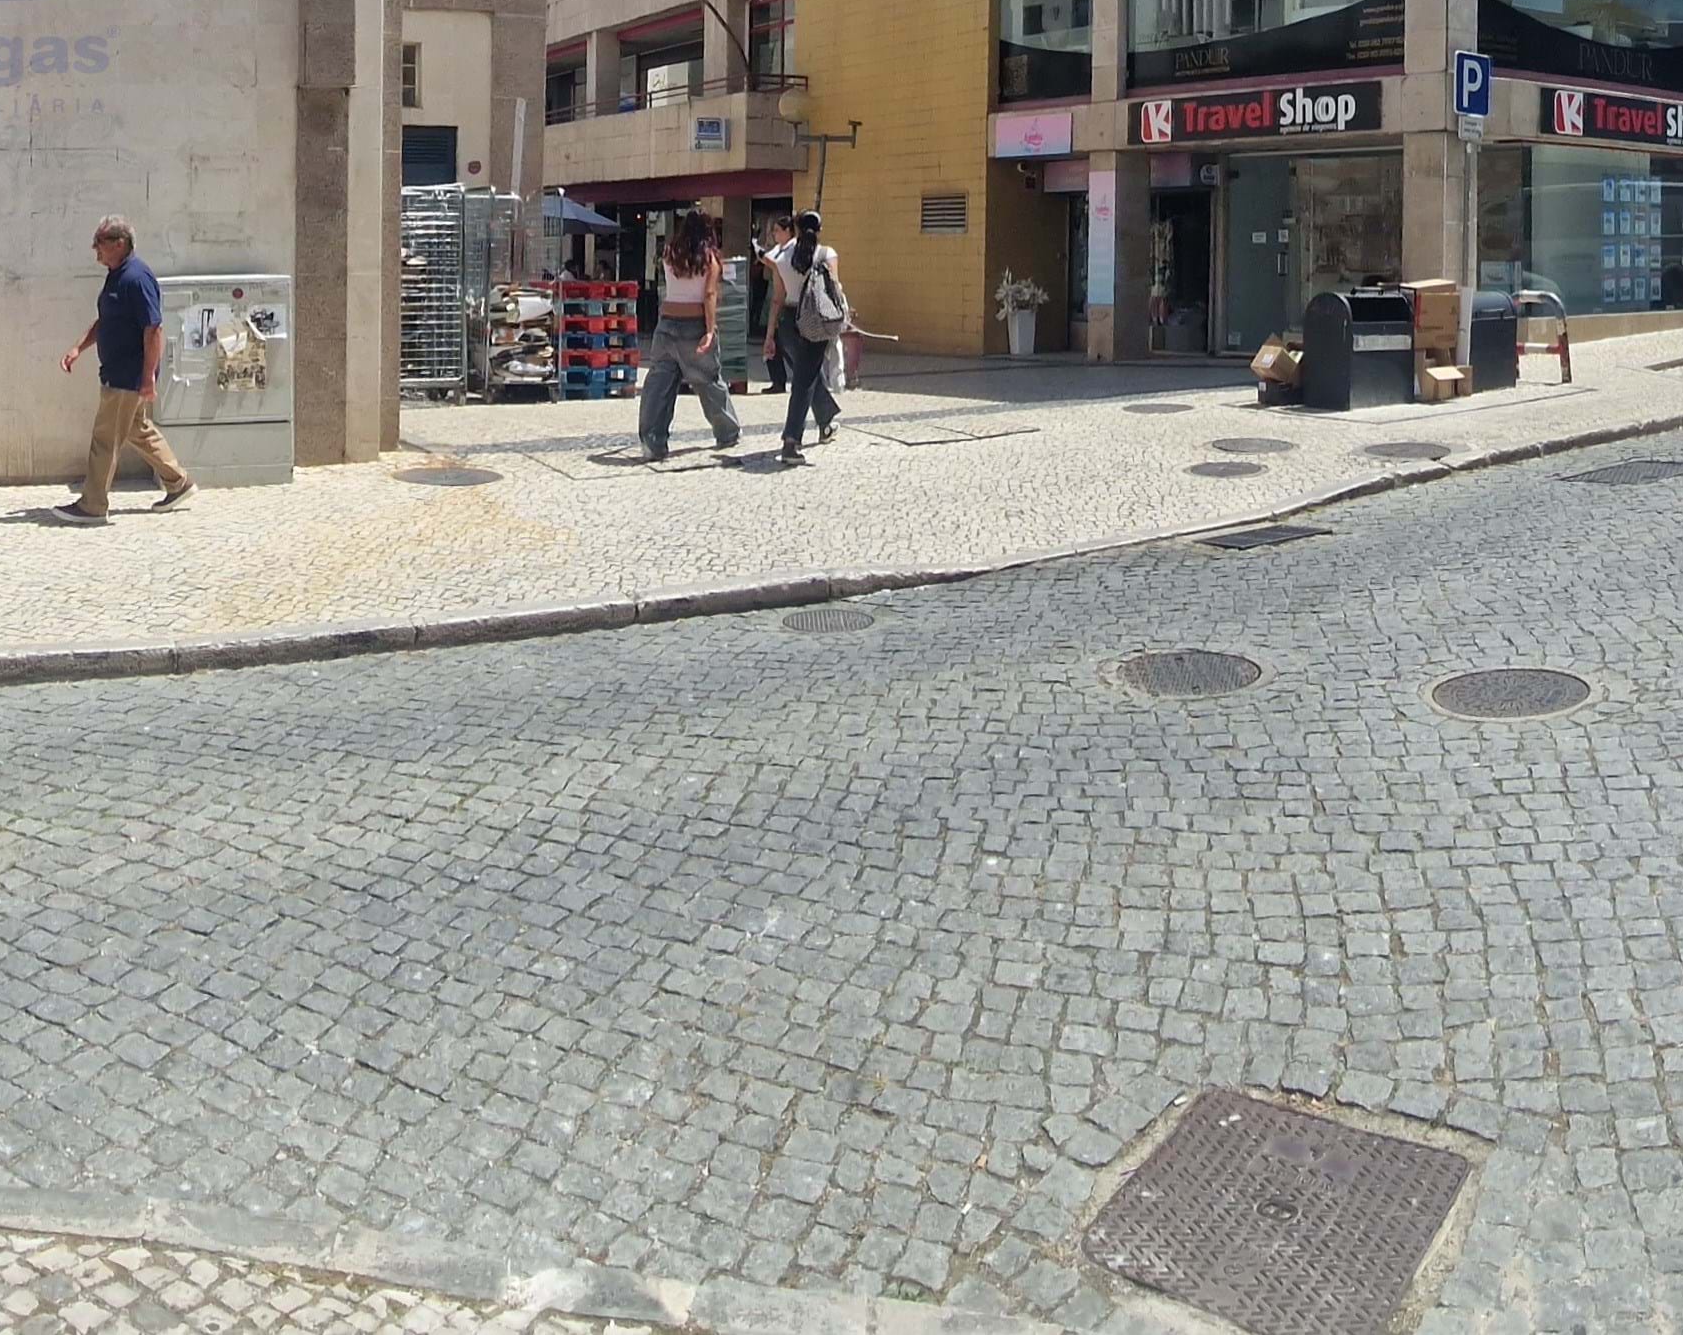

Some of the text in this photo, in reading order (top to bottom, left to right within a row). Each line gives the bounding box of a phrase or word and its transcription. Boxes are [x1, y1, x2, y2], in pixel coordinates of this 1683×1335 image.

[1462, 59, 1483, 108] P
[1184, 91, 1275, 133] Travel
[1594, 99, 1663, 135] Travel
